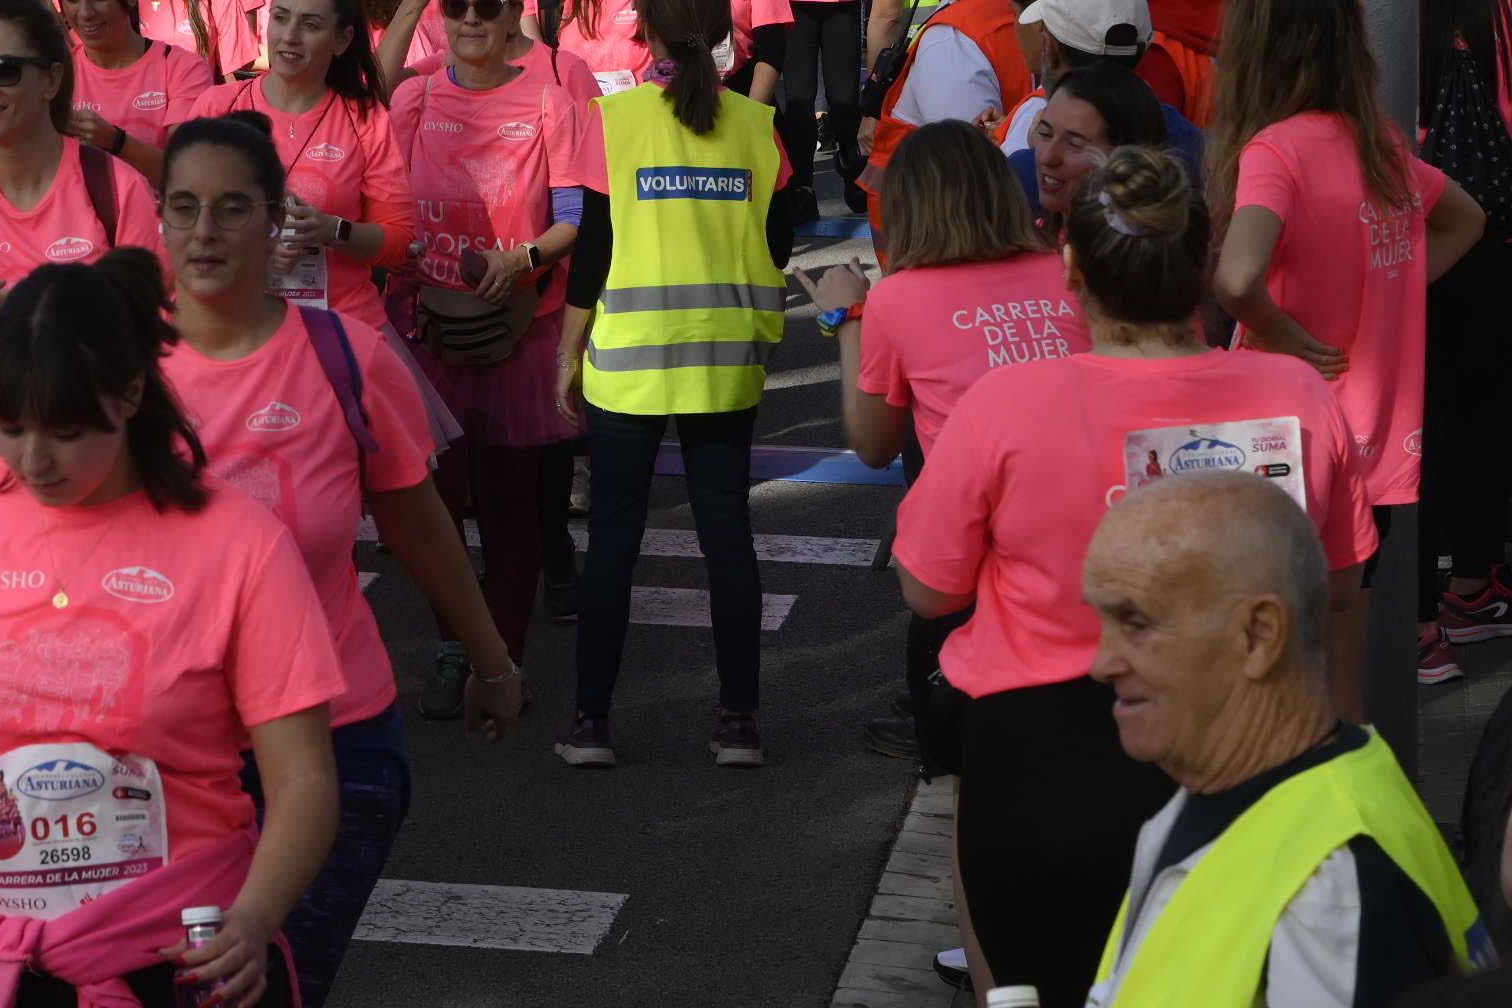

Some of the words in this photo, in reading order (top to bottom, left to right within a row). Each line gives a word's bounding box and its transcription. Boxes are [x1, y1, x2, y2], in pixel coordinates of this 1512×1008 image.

[639, 175, 745, 195] VOLUNTARIS
[418, 199, 445, 223] TU
[1369, 240, 1413, 270] MUJER
[952, 299, 1076, 330] CARRERA
[984, 323, 1020, 345] DE
[1027, 319, 1061, 339] LA
[986, 338, 1073, 368] MUJER
[1252, 442, 1288, 453] SUMA
[1175, 456, 1239, 471] ASTURIANA
[108, 576, 170, 598] ASTURIANA
[24, 773, 104, 792] ASTURIANA
[30, 811, 98, 842] 016
[39, 845, 92, 866] 26598
[46, 870, 63, 884] DE
[64, 869, 80, 882] LA
[81, 866, 120, 882] MUJER
[123, 862, 149, 876] 2023
